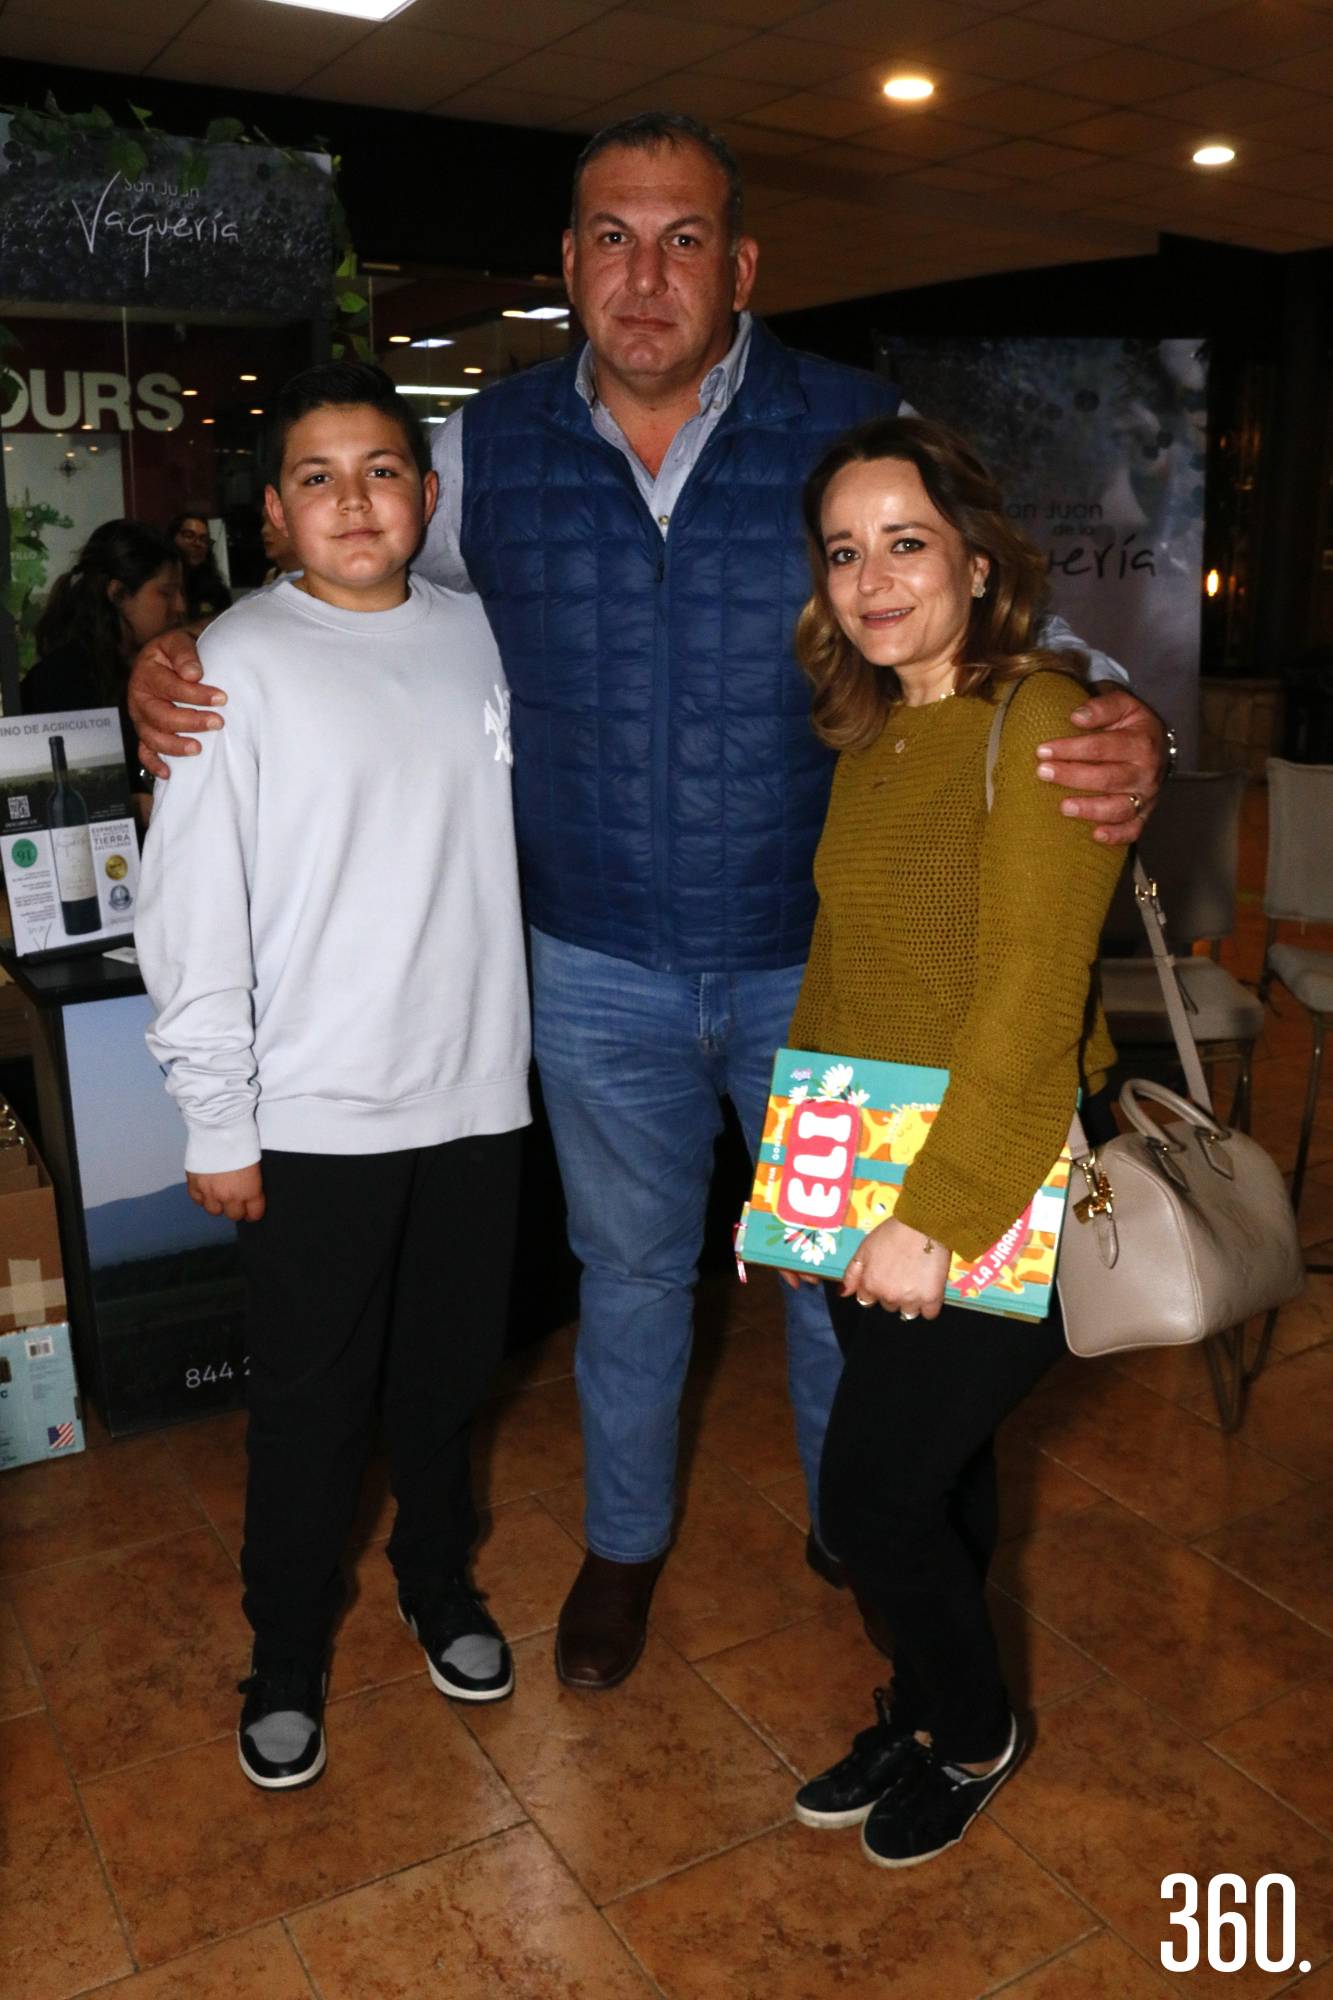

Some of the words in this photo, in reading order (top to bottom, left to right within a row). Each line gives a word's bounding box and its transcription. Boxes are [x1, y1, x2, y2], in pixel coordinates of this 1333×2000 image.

[72, 170, 240, 279] Vaquería
[1007, 501, 1037, 520] an
[1045, 500, 1104, 520] Juan
[1050, 532, 1157, 579] ería
[0, 726, 21, 737] INO
[23, 724, 39, 736] DE
[42, 717, 111, 733] AGRICULTOR
[786, 1110, 852, 1219] ELI
[971, 1265, 995, 1287] LA
[185, 1361, 235, 1389] 844
